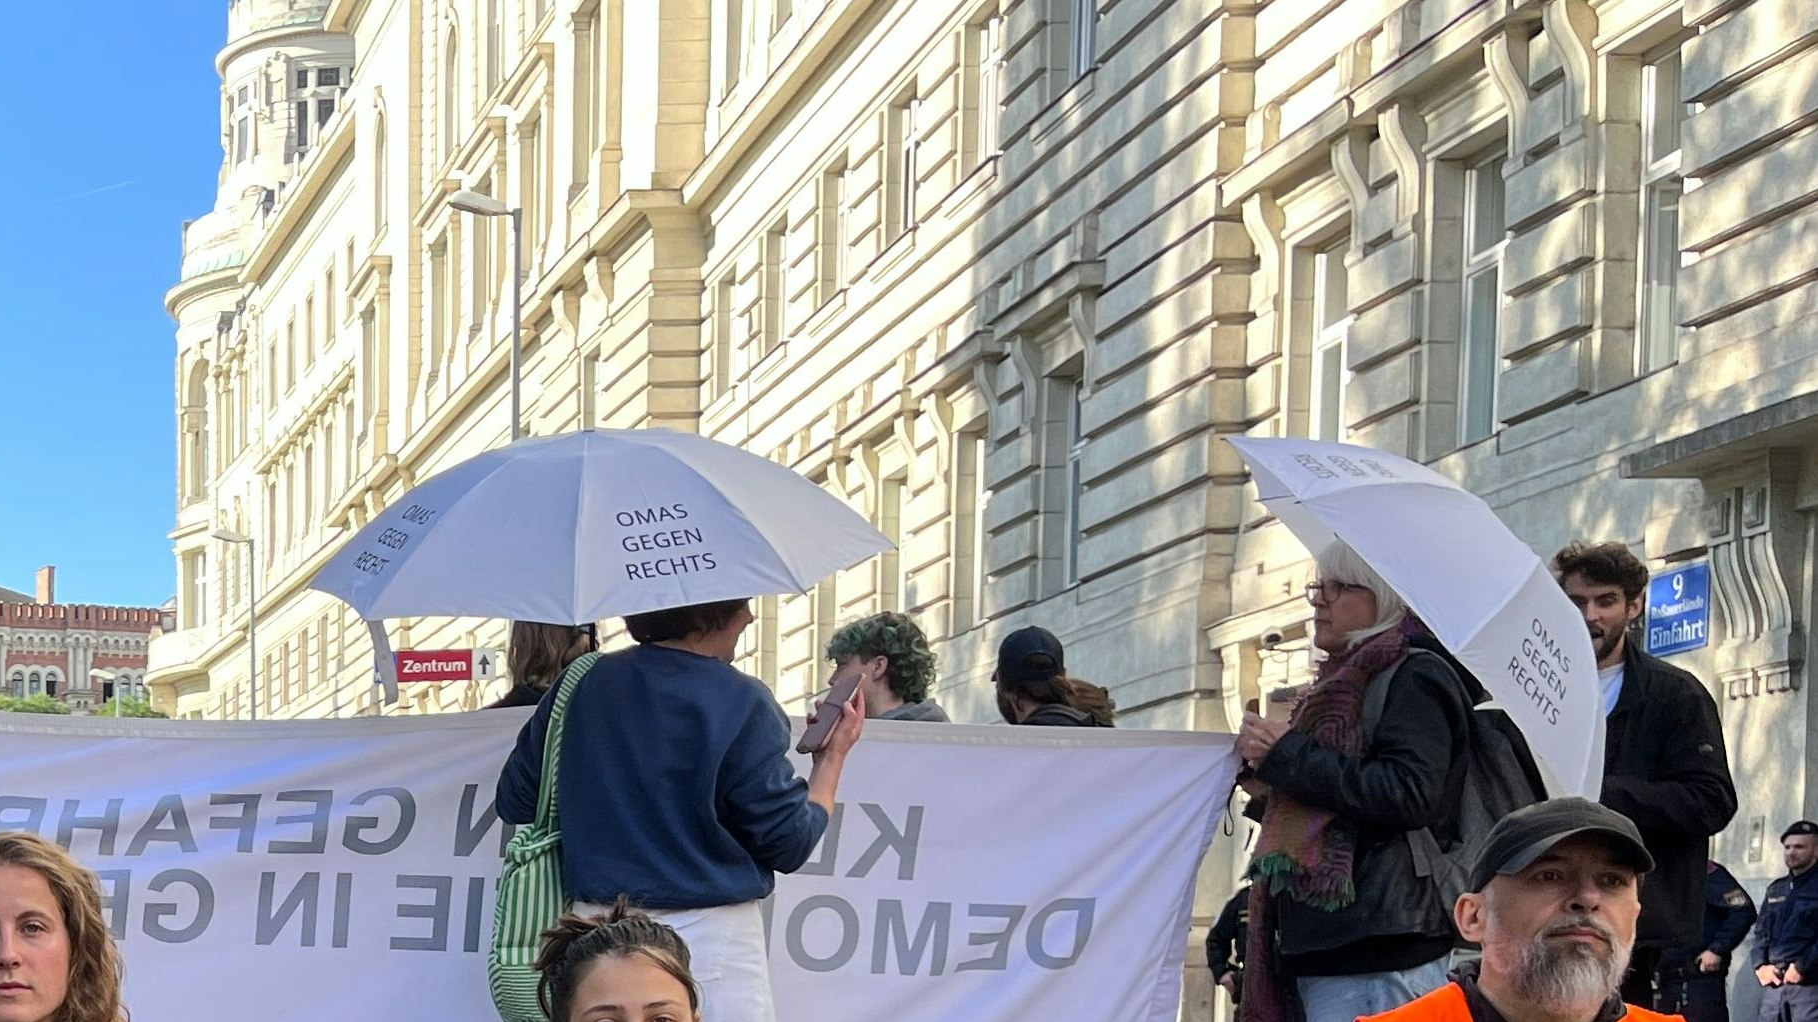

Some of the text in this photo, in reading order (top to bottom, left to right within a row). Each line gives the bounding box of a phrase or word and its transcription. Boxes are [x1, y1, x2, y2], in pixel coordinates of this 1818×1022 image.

[402, 504, 437, 526] OMAS
[616, 503, 688, 527] OMAS
[377, 528, 413, 551] GEGEN
[622, 527, 704, 552] GEGEN
[625, 552, 717, 581] RECHTS
[1672, 573, 1684, 600] 9
[1532, 618, 1571, 673] OMAS
[1649, 618, 1704, 649] Einfahrt
[402, 659, 467, 674] Zentrum
[1522, 638, 1567, 700] GEGEN
[1508, 656, 1560, 726] RECHTS
